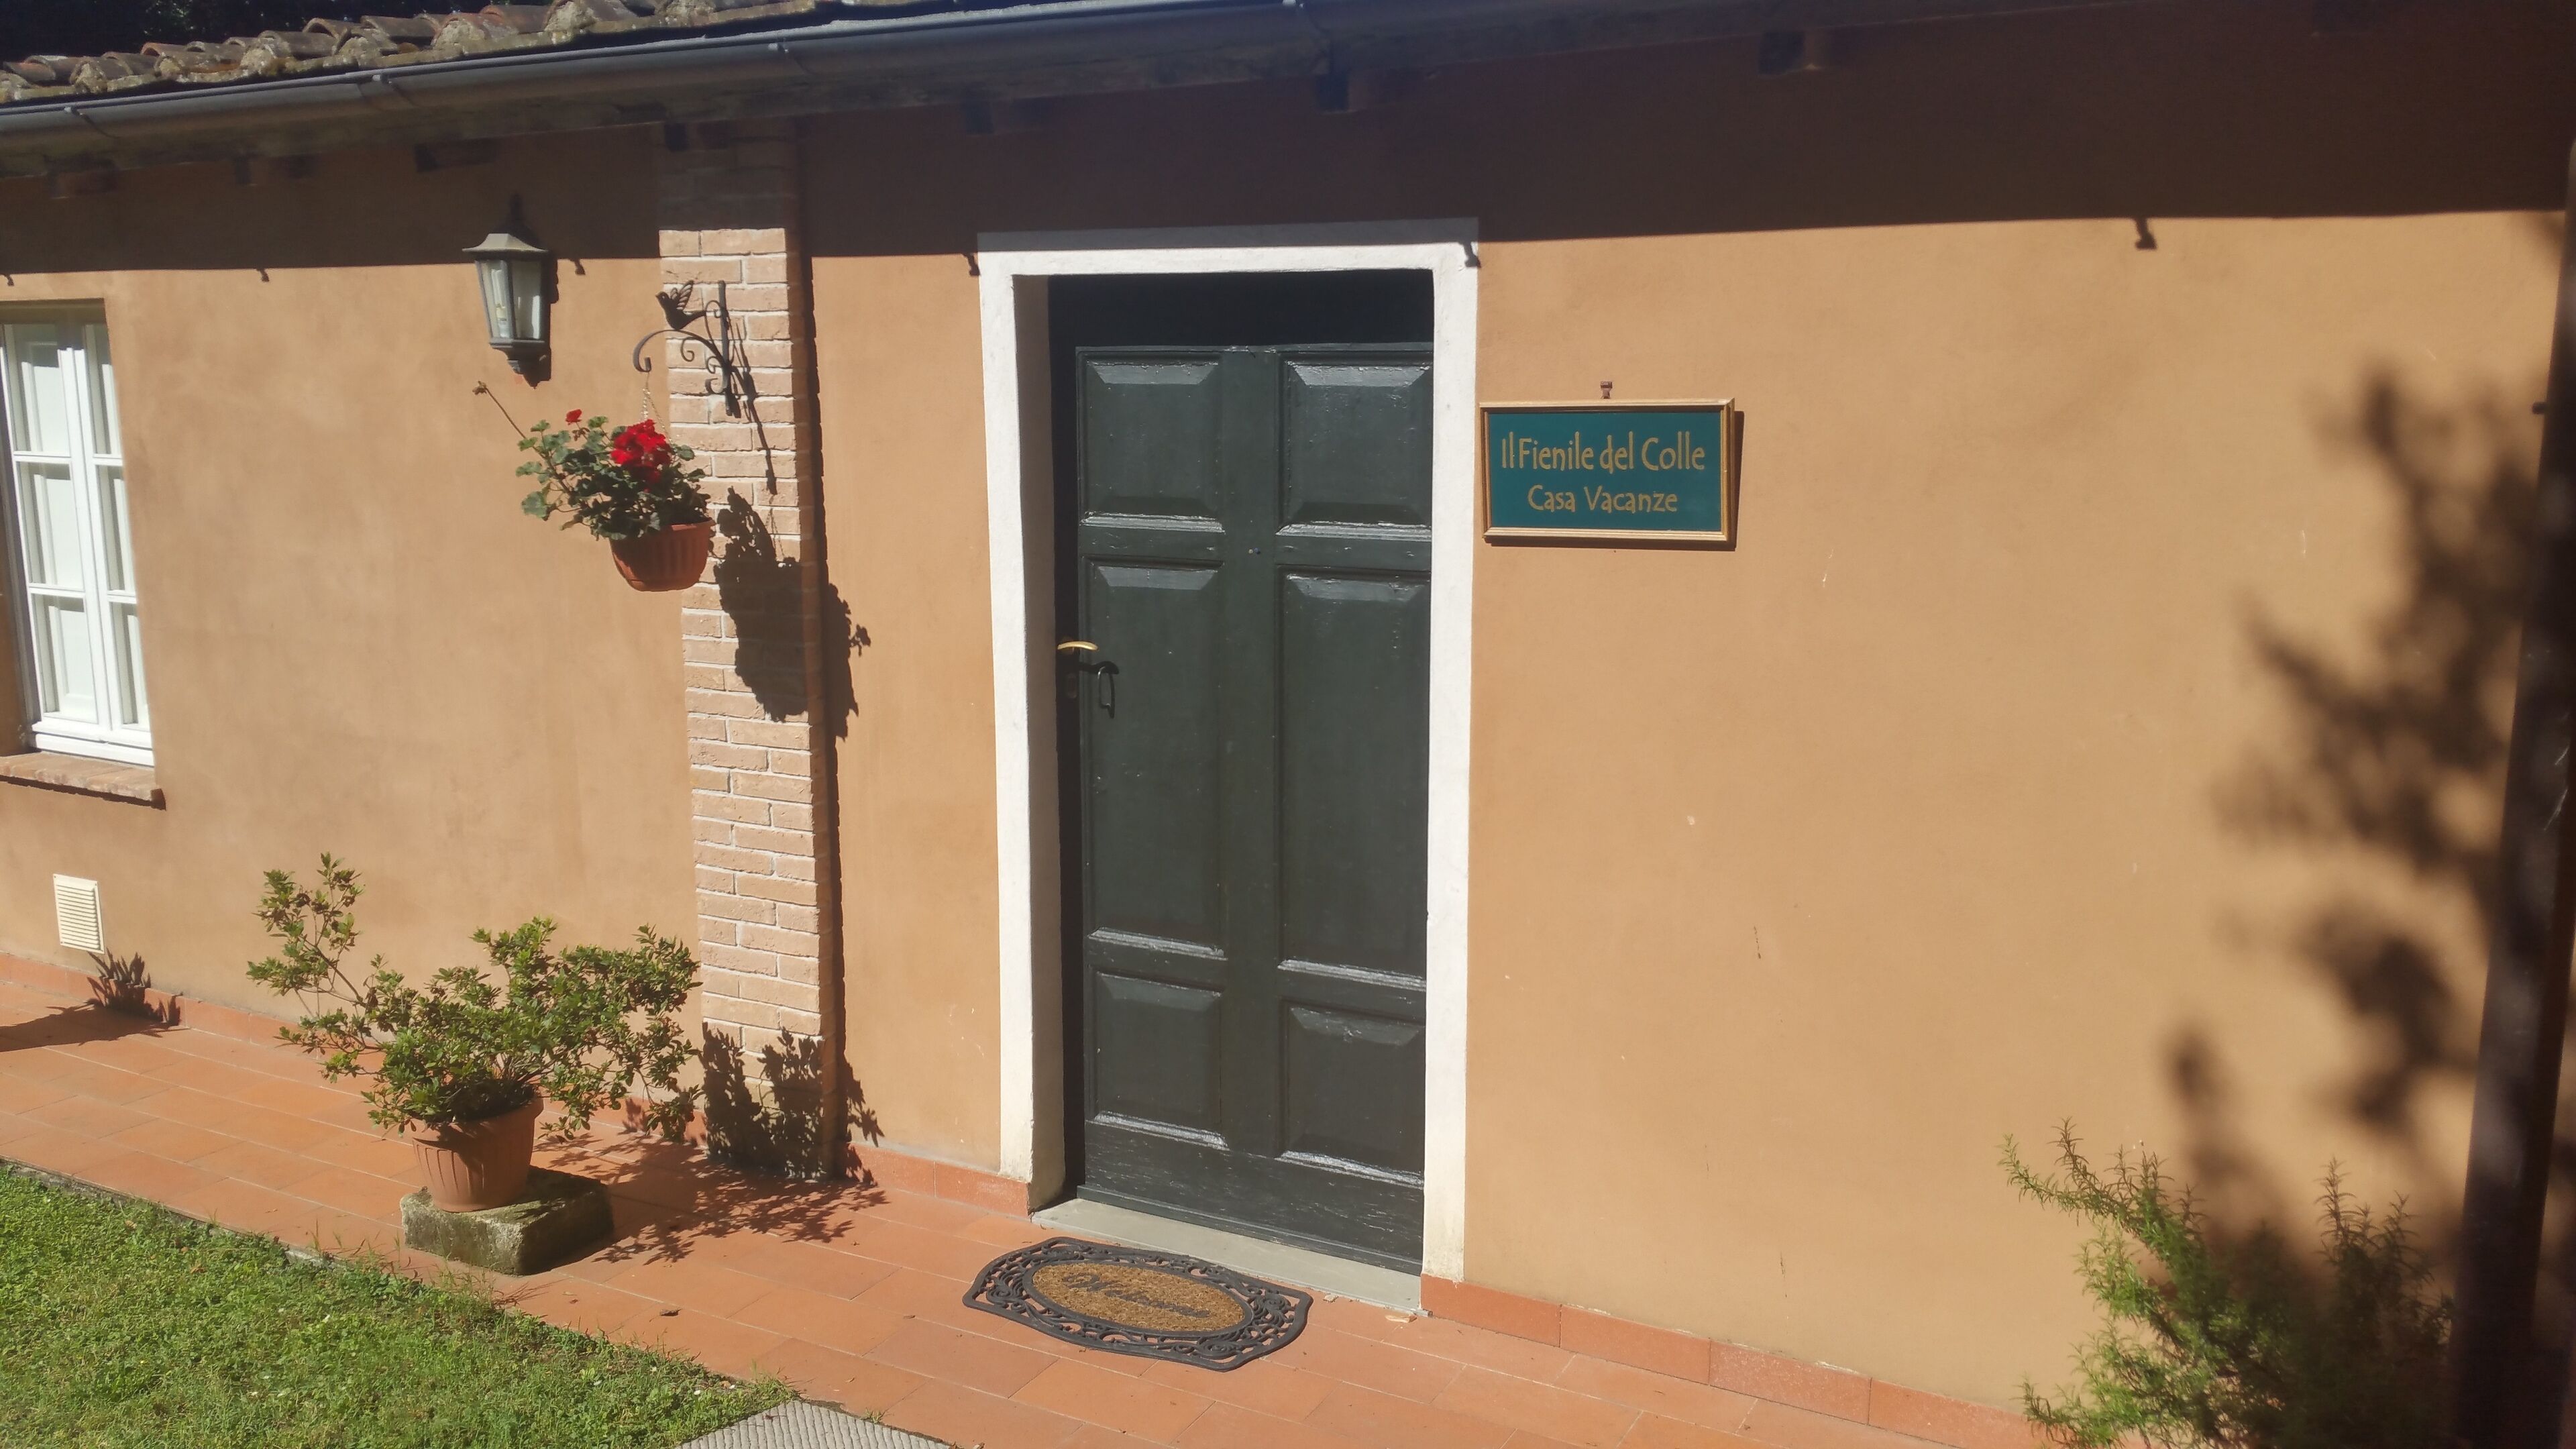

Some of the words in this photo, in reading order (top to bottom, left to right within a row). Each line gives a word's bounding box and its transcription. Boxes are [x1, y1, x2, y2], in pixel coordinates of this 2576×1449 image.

[1517, 431, 1595, 472] Fienile
[1599, 431, 1635, 474] del
[1641, 431, 1705, 471] Colle
[1527, 484, 1576, 513] Casa
[1583, 485, 1678, 514] Vacanze
